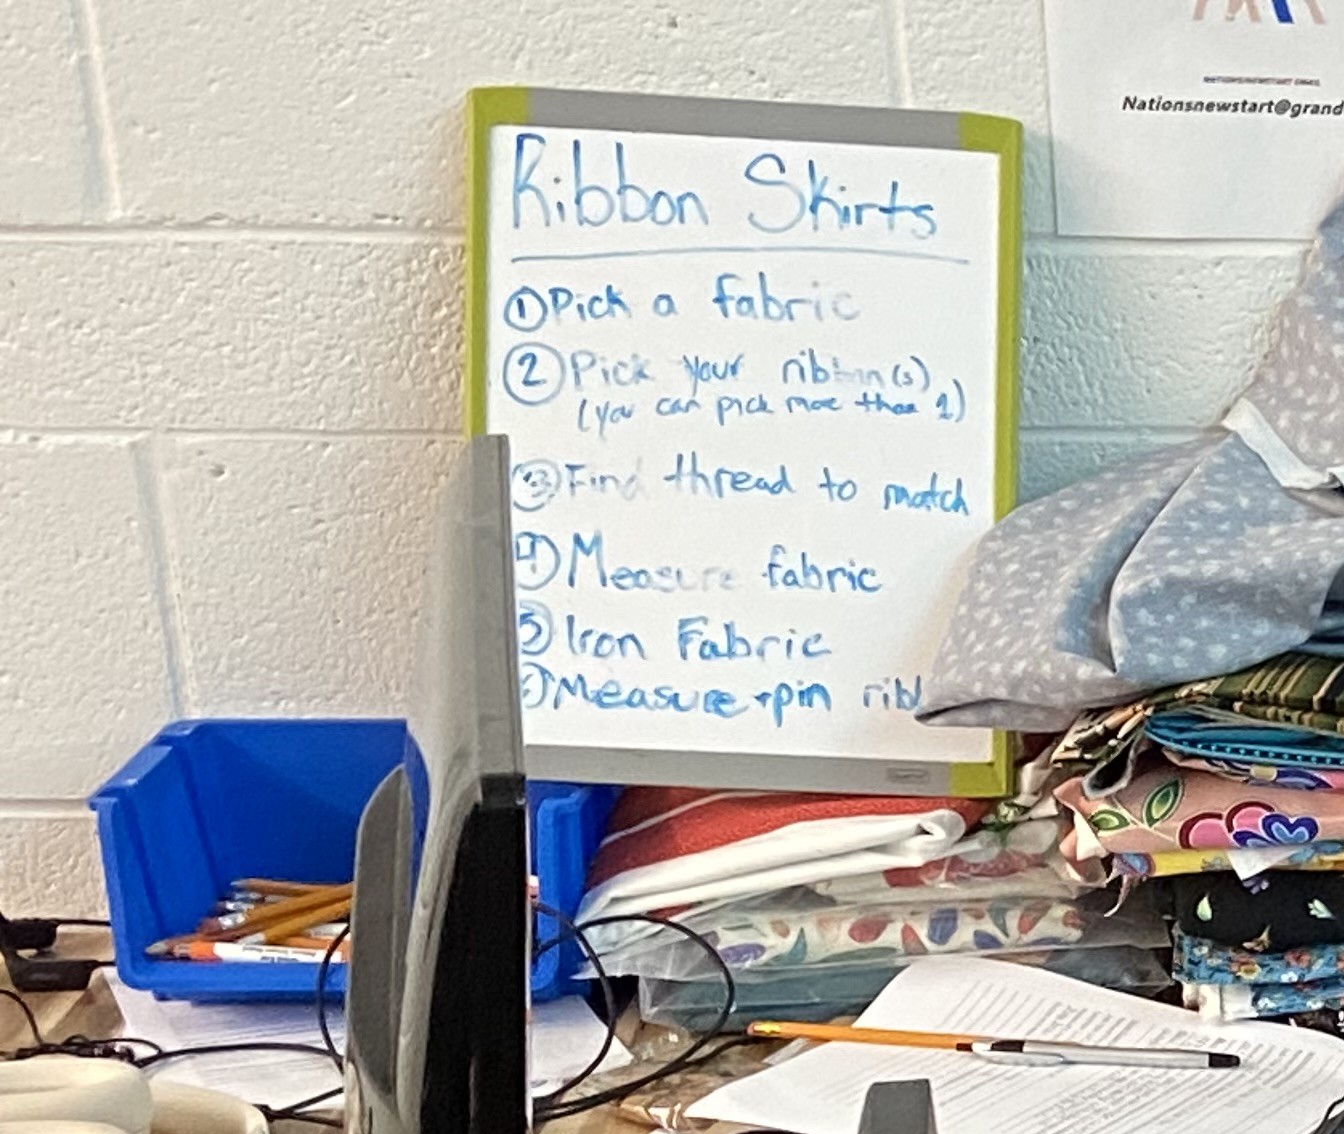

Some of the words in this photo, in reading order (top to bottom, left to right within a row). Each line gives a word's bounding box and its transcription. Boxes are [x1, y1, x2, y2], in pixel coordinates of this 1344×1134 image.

[511, 133, 709, 229] Ribbon
[744, 152, 940, 238] Skirts
[549, 285, 632, 321] Pick
[652, 292, 679, 317] a
[712, 272, 862, 323] fabric
[570, 348, 654, 388] Pick
[683, 354, 745, 396] your
[655, 396, 700, 416] can
[717, 393, 775, 427] pick
[564, 455, 643, 502] Find
[662, 450, 797, 499] thread
[818, 466, 858, 502] to
[884, 470, 971, 516] match
[567, 528, 738, 593] Measure
[761, 543, 884, 593] fabric
[566, 613, 649, 661] Iron
[677, 614, 833, 662] Fabric
[553, 672, 750, 719] Measure
